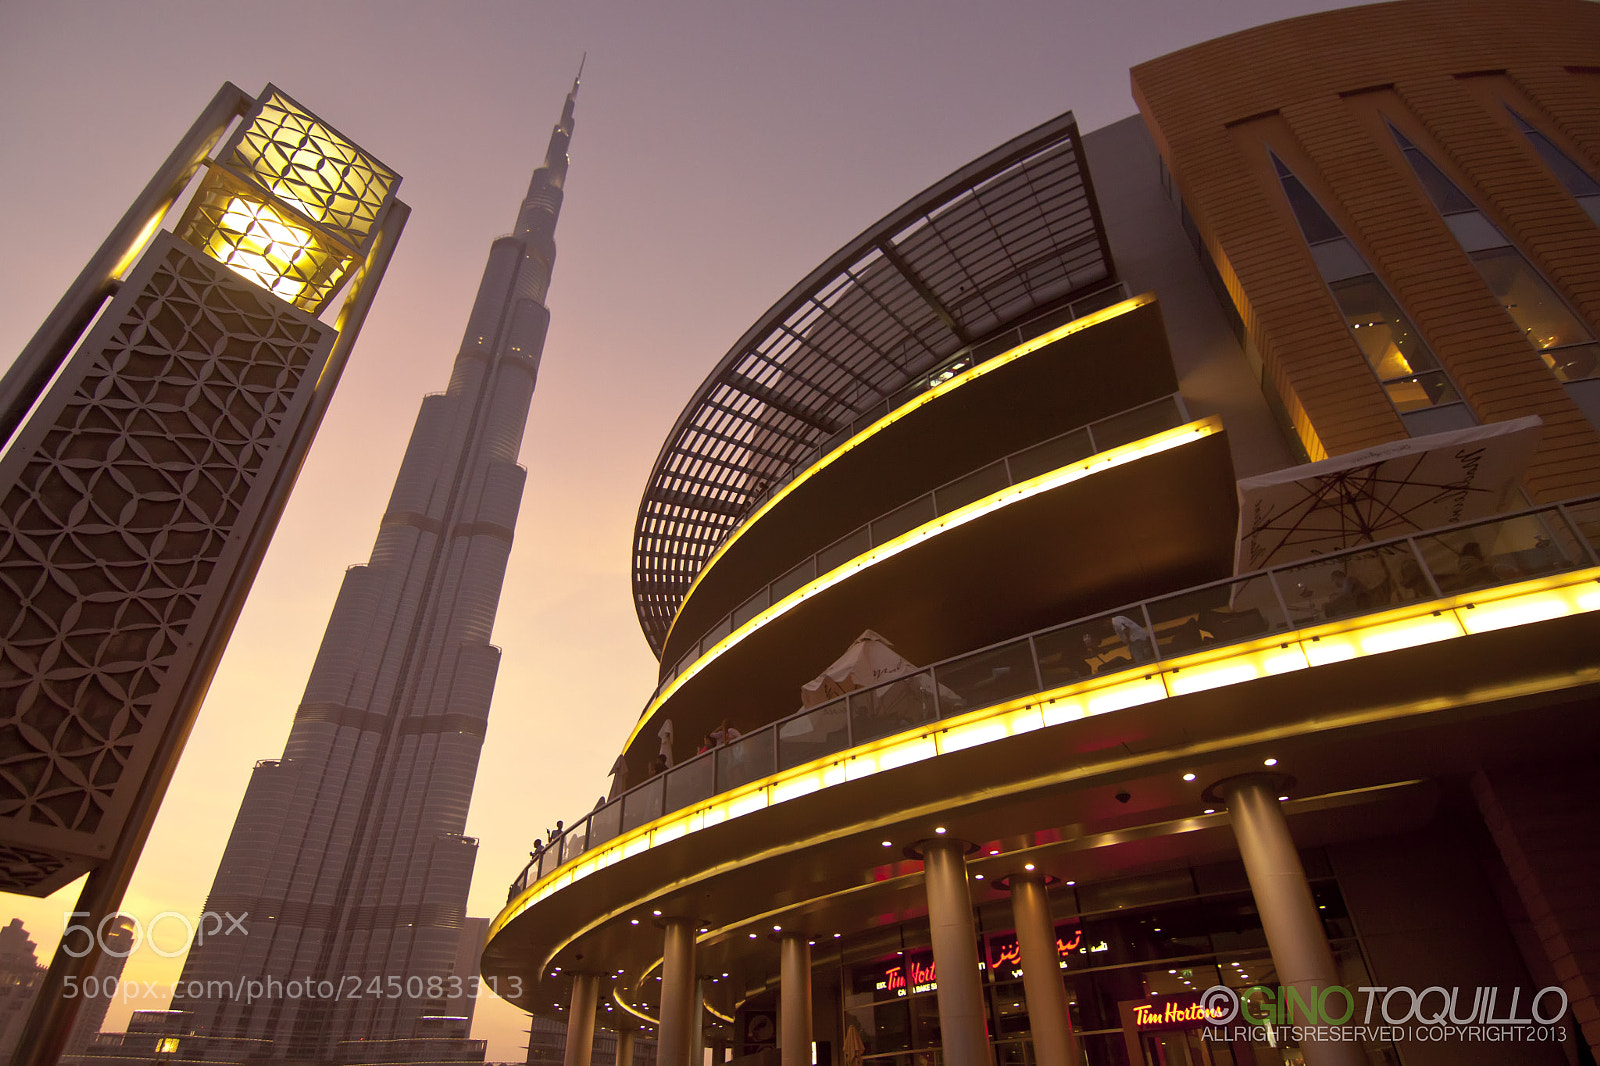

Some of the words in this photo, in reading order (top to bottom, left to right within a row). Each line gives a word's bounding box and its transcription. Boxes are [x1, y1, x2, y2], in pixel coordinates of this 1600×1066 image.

[911, 961, 937, 985] Hort
[1132, 1004, 1163, 1026] Tim
[1164, 1001, 1224, 1024] Hortons
